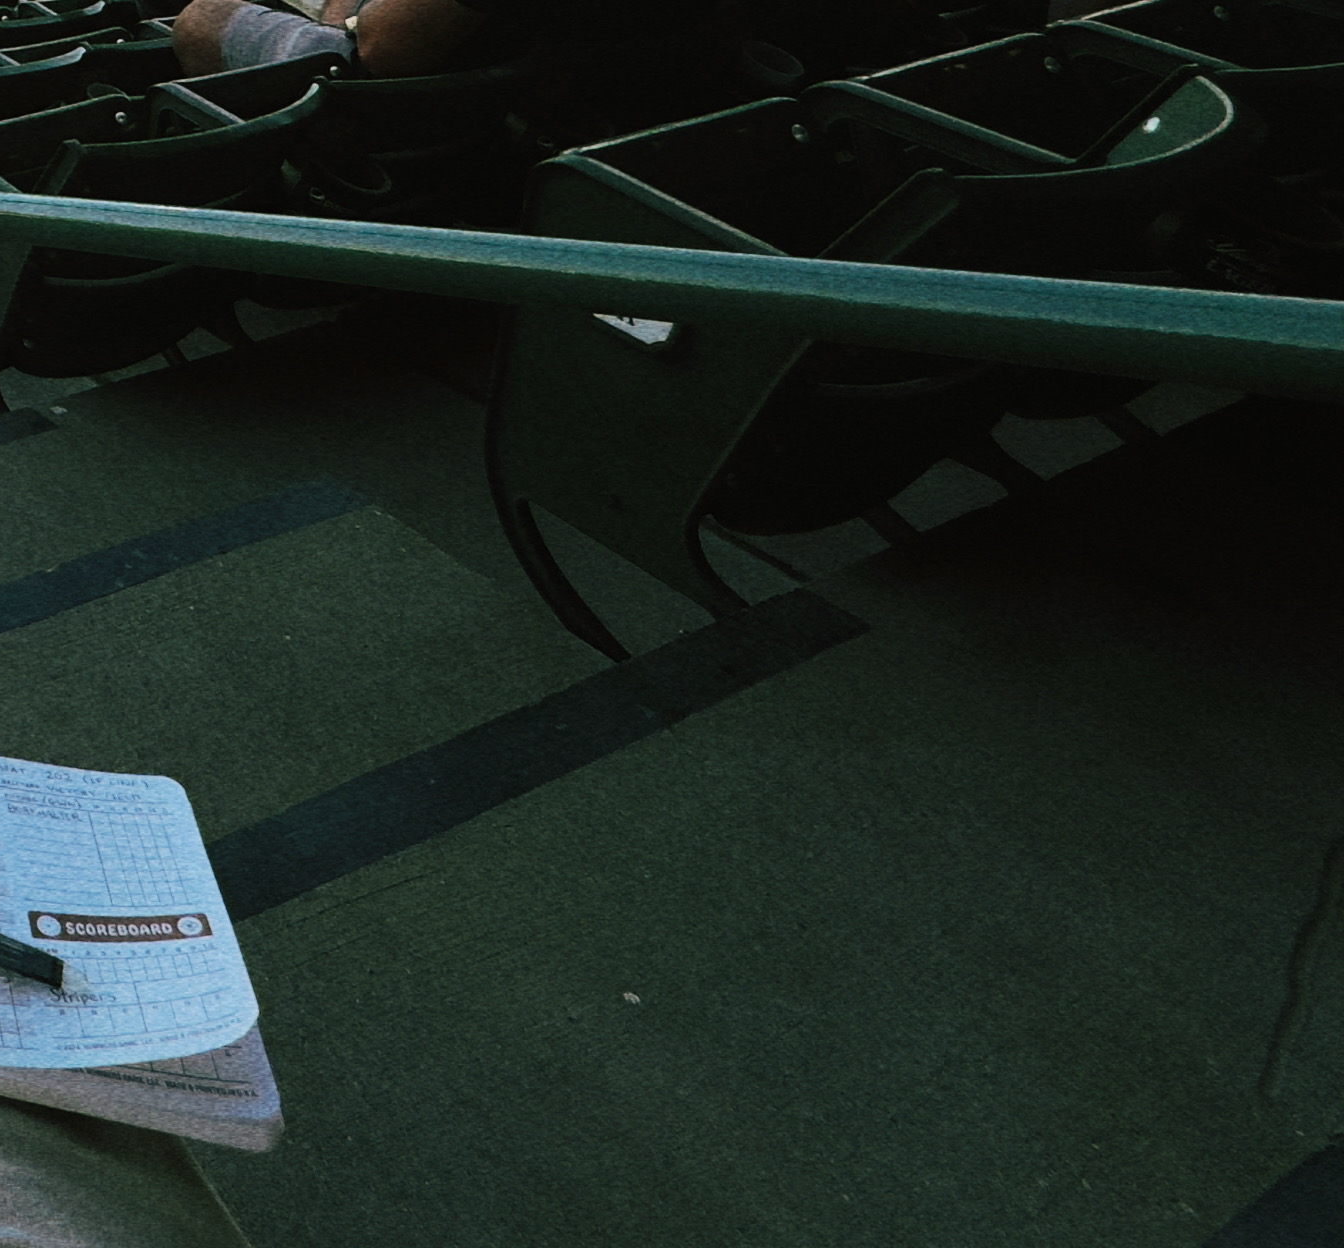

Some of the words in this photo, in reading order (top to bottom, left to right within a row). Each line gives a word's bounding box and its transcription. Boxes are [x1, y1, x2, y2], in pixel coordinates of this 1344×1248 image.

[46, 771, 73, 782] 202
[65, 921, 173, 937] SCOREBOARD
[49, 987, 117, 1004] Stripers
